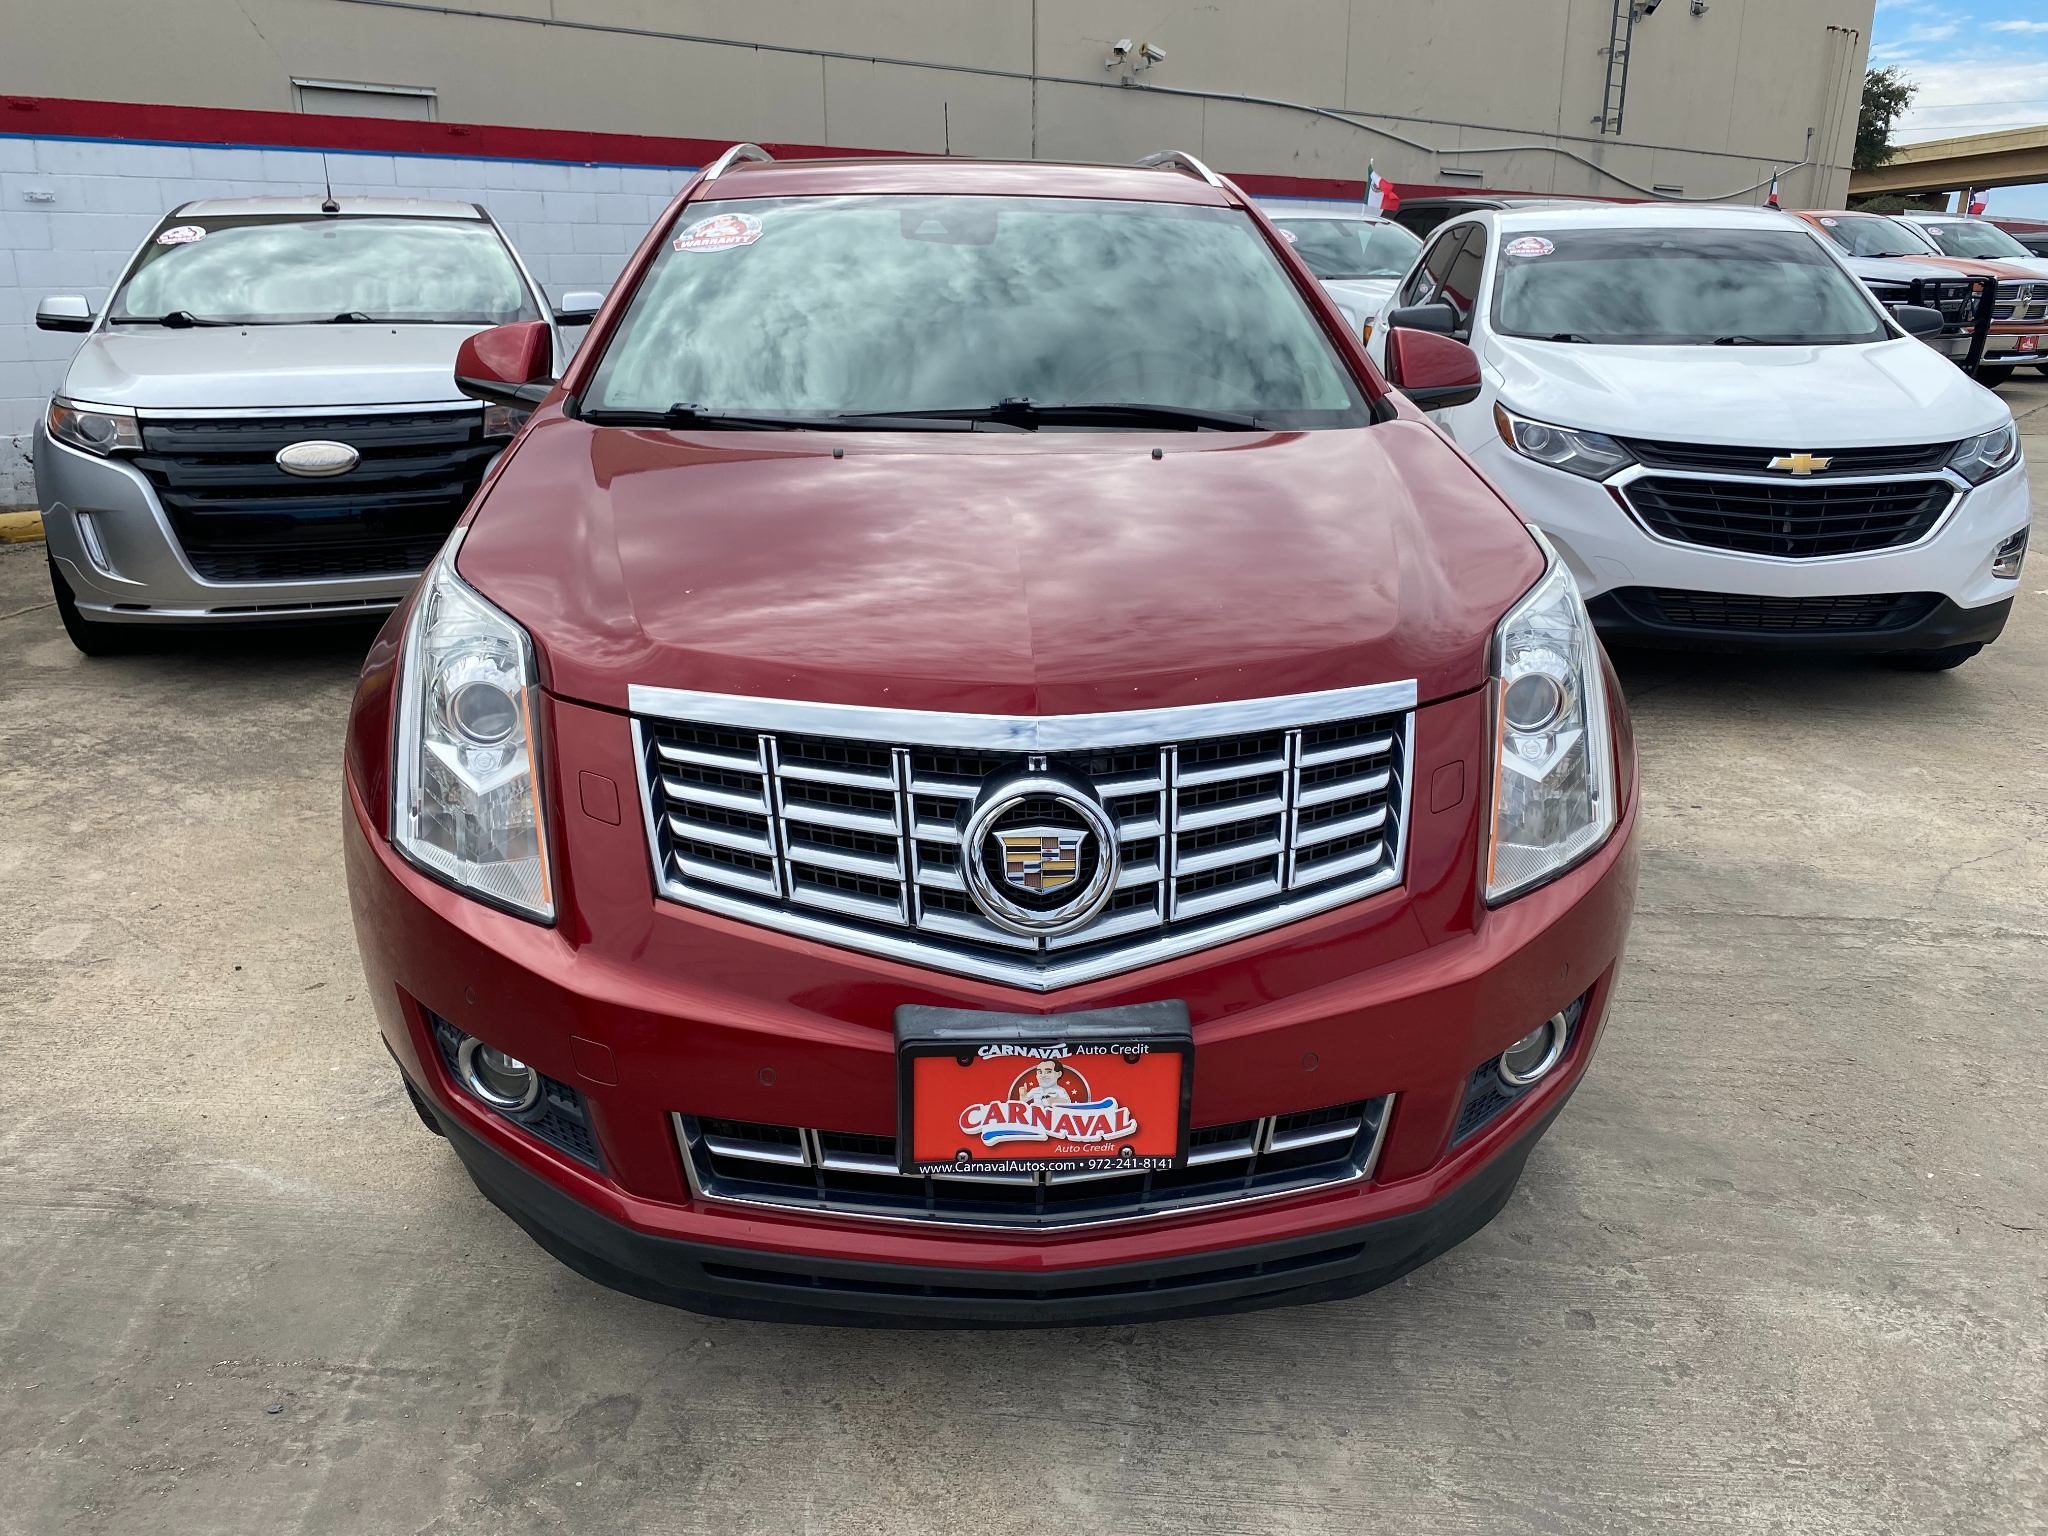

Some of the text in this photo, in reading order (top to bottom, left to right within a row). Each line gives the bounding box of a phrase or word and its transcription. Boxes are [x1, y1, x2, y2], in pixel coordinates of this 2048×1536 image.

[681, 236, 751, 248] WARRANTY
[977, 1043, 1150, 1059] CARNAVAL Auto Credit
[960, 1102, 1133, 1137] CARNAVAL
[1054, 1143, 1115, 1153] Auto Credit
[919, 1158, 1172, 1174] www.CarnavalAutos.com 972-241-8141
